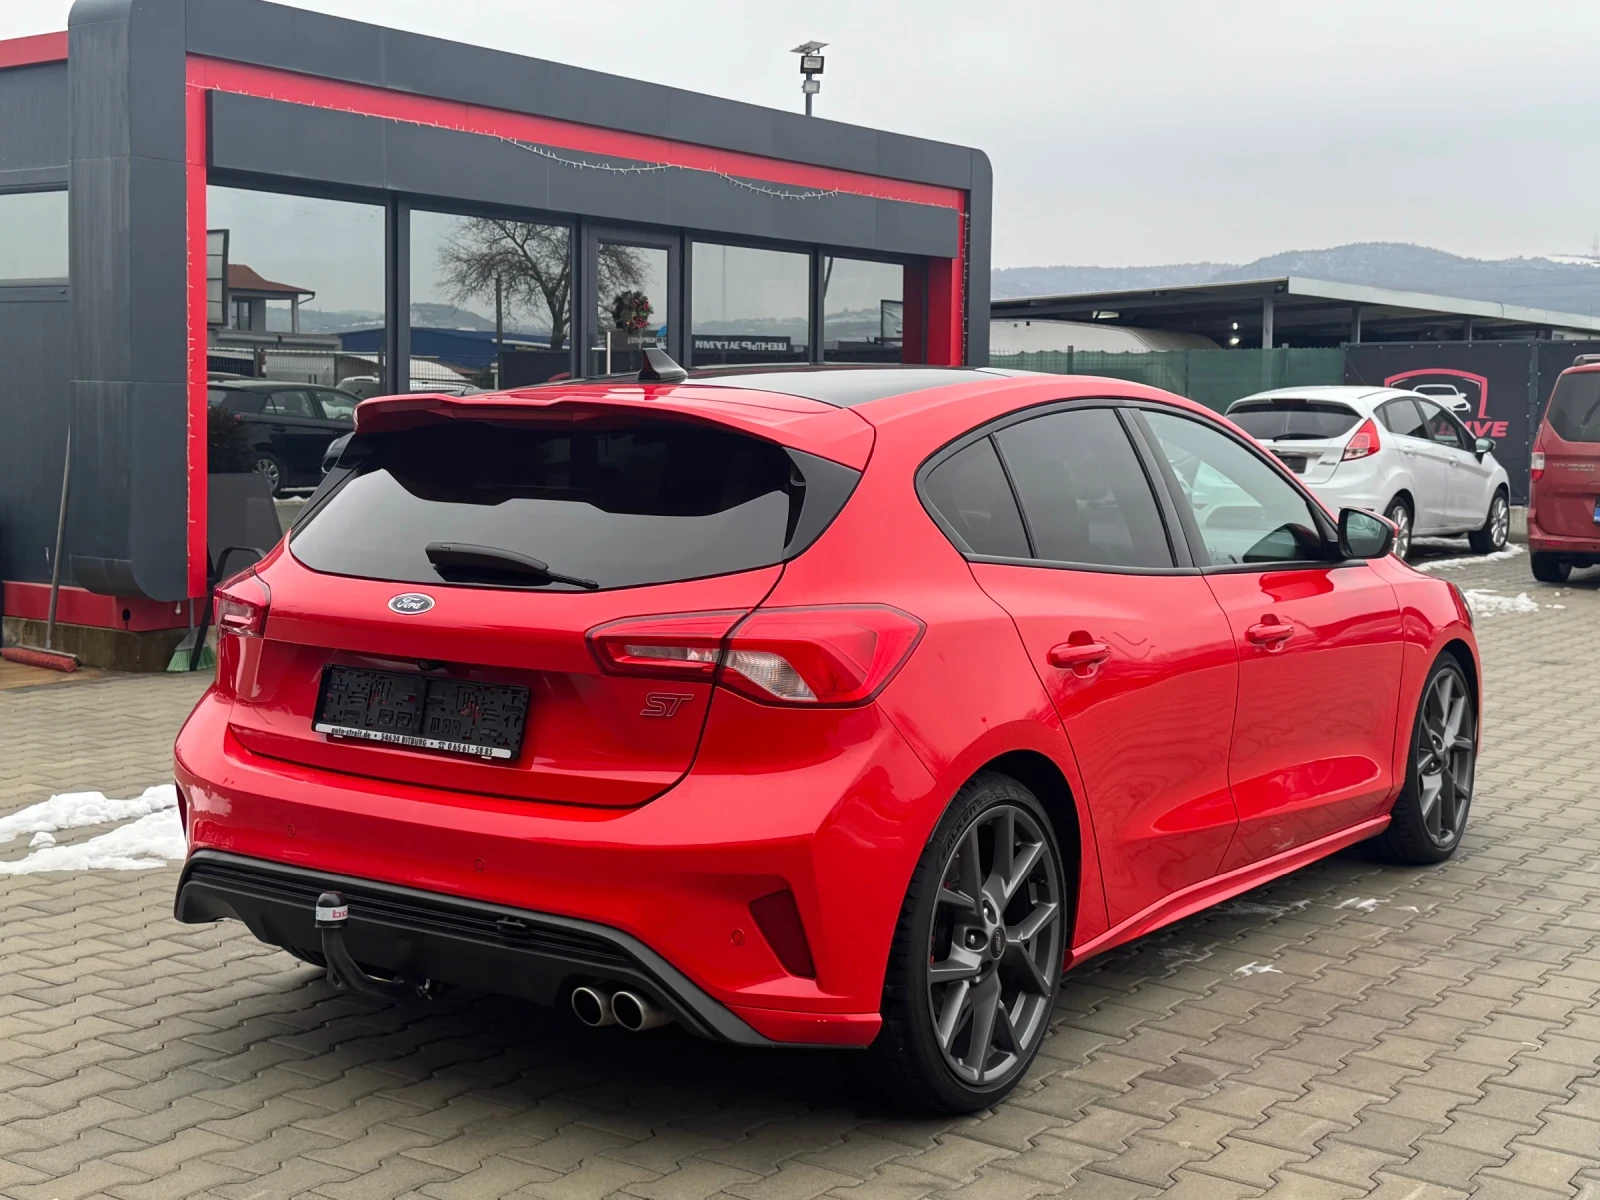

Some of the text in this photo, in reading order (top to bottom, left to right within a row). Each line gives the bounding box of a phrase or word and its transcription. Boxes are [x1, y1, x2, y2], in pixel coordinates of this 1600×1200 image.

[640, 691, 694, 717] ST
[331, 727, 371, 739] auto-streit.de
[381, 732, 400, 743] 54634
[401, 736, 427, 747] BITBURG
